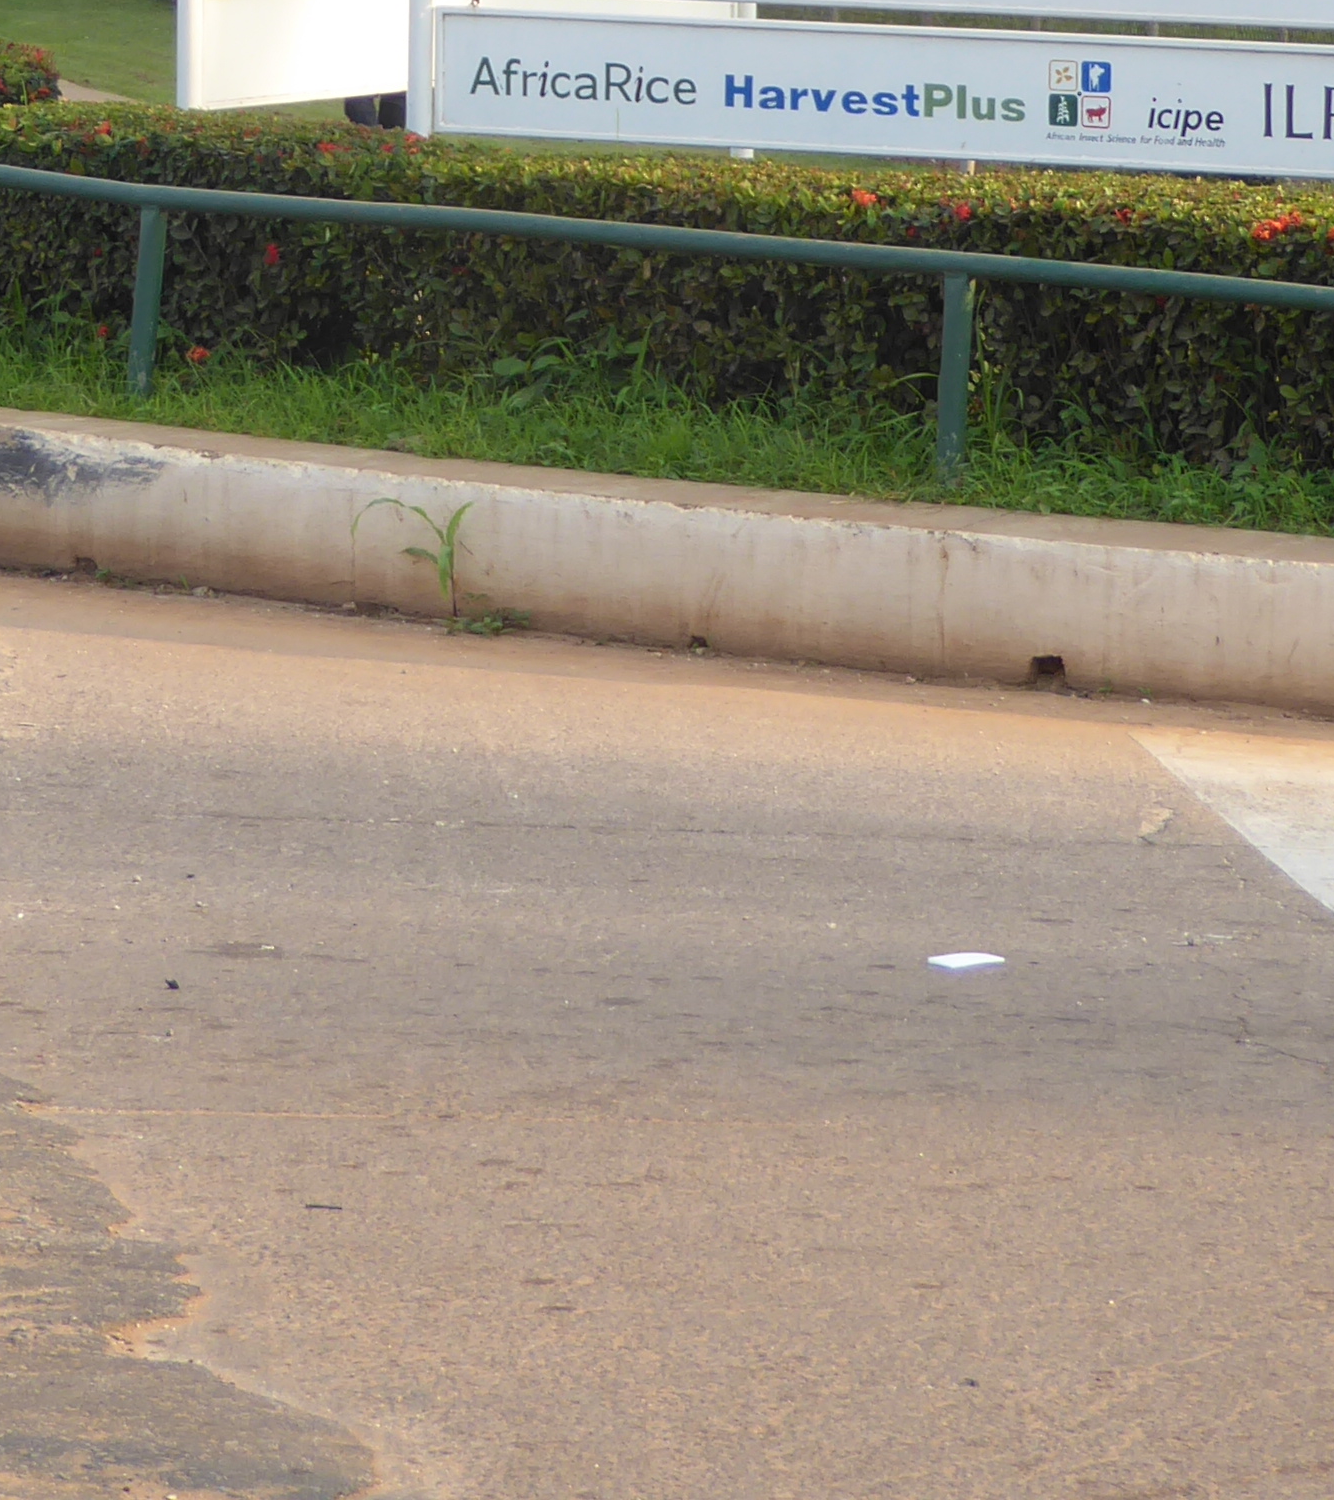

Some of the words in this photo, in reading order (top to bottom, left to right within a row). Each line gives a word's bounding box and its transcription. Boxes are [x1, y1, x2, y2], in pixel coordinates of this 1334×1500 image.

[469, 56, 697, 106] AfricaRice
[724, 74, 1026, 122] HarvestPlus
[1147, 97, 1225, 138] icipe
[1046, 132, 1076, 142] African
[1079, 133, 1104, 143] Insect
[1106, 134, 1137, 144] Science
[1140, 135, 1152, 144] for
[1154, 136, 1175, 146] Food
[1177, 137, 1192, 147] and
[1194, 137, 1226, 148] Health
